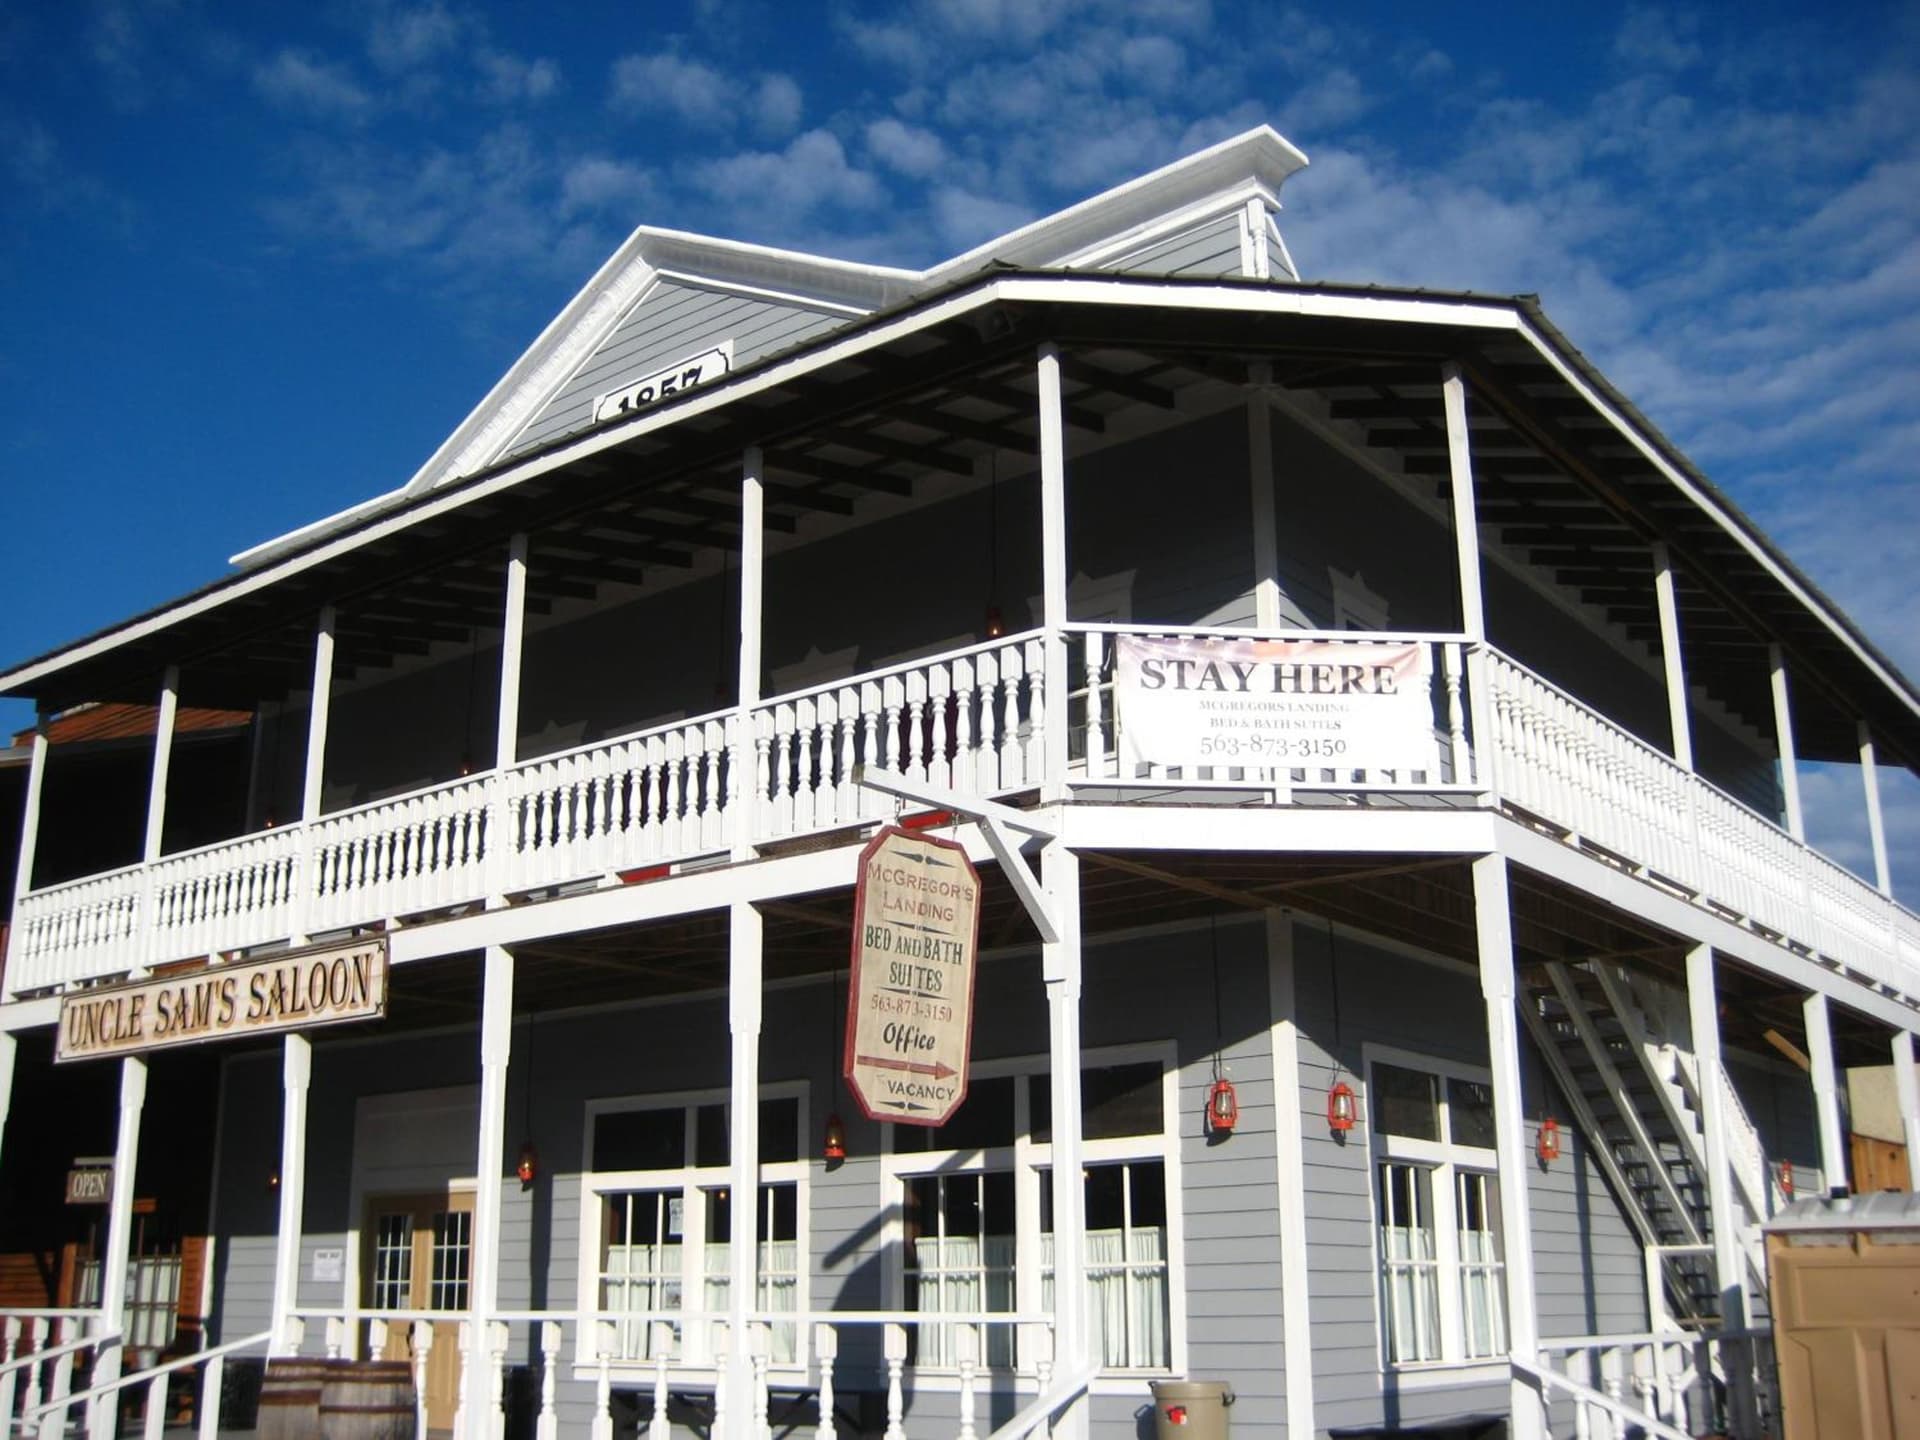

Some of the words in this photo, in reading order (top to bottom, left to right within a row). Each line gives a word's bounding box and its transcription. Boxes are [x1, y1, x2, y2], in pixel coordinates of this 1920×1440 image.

[618, 366, 702, 413] 1857
[1140, 658, 1256, 693] STAY
[1272, 662, 1399, 696] HERE
[1288, 702, 1350, 713] LANDING
[1209, 717, 1238, 729] BED
[1240, 718, 1250, 729] &
[1254, 718, 1291, 730] BATH
[1200, 733, 1347, 758] 563-873-3150
[883, 890, 954, 921] LANDING
[865, 924, 893, 951] BED
[894, 935, 922, 958] AND
[922, 935, 964, 966] BATH
[889, 961, 943, 992] SUITES
[68, 993, 147, 1048] UNCLE
[153, 975, 238, 1036] SAM'S
[245, 951, 376, 1021] SALOON
[870, 994, 953, 1023] 563-873-3150
[883, 1021, 936, 1054] Office
[887, 1079, 955, 1101] VACANCY
[72, 1171, 107, 1198] OPEN
